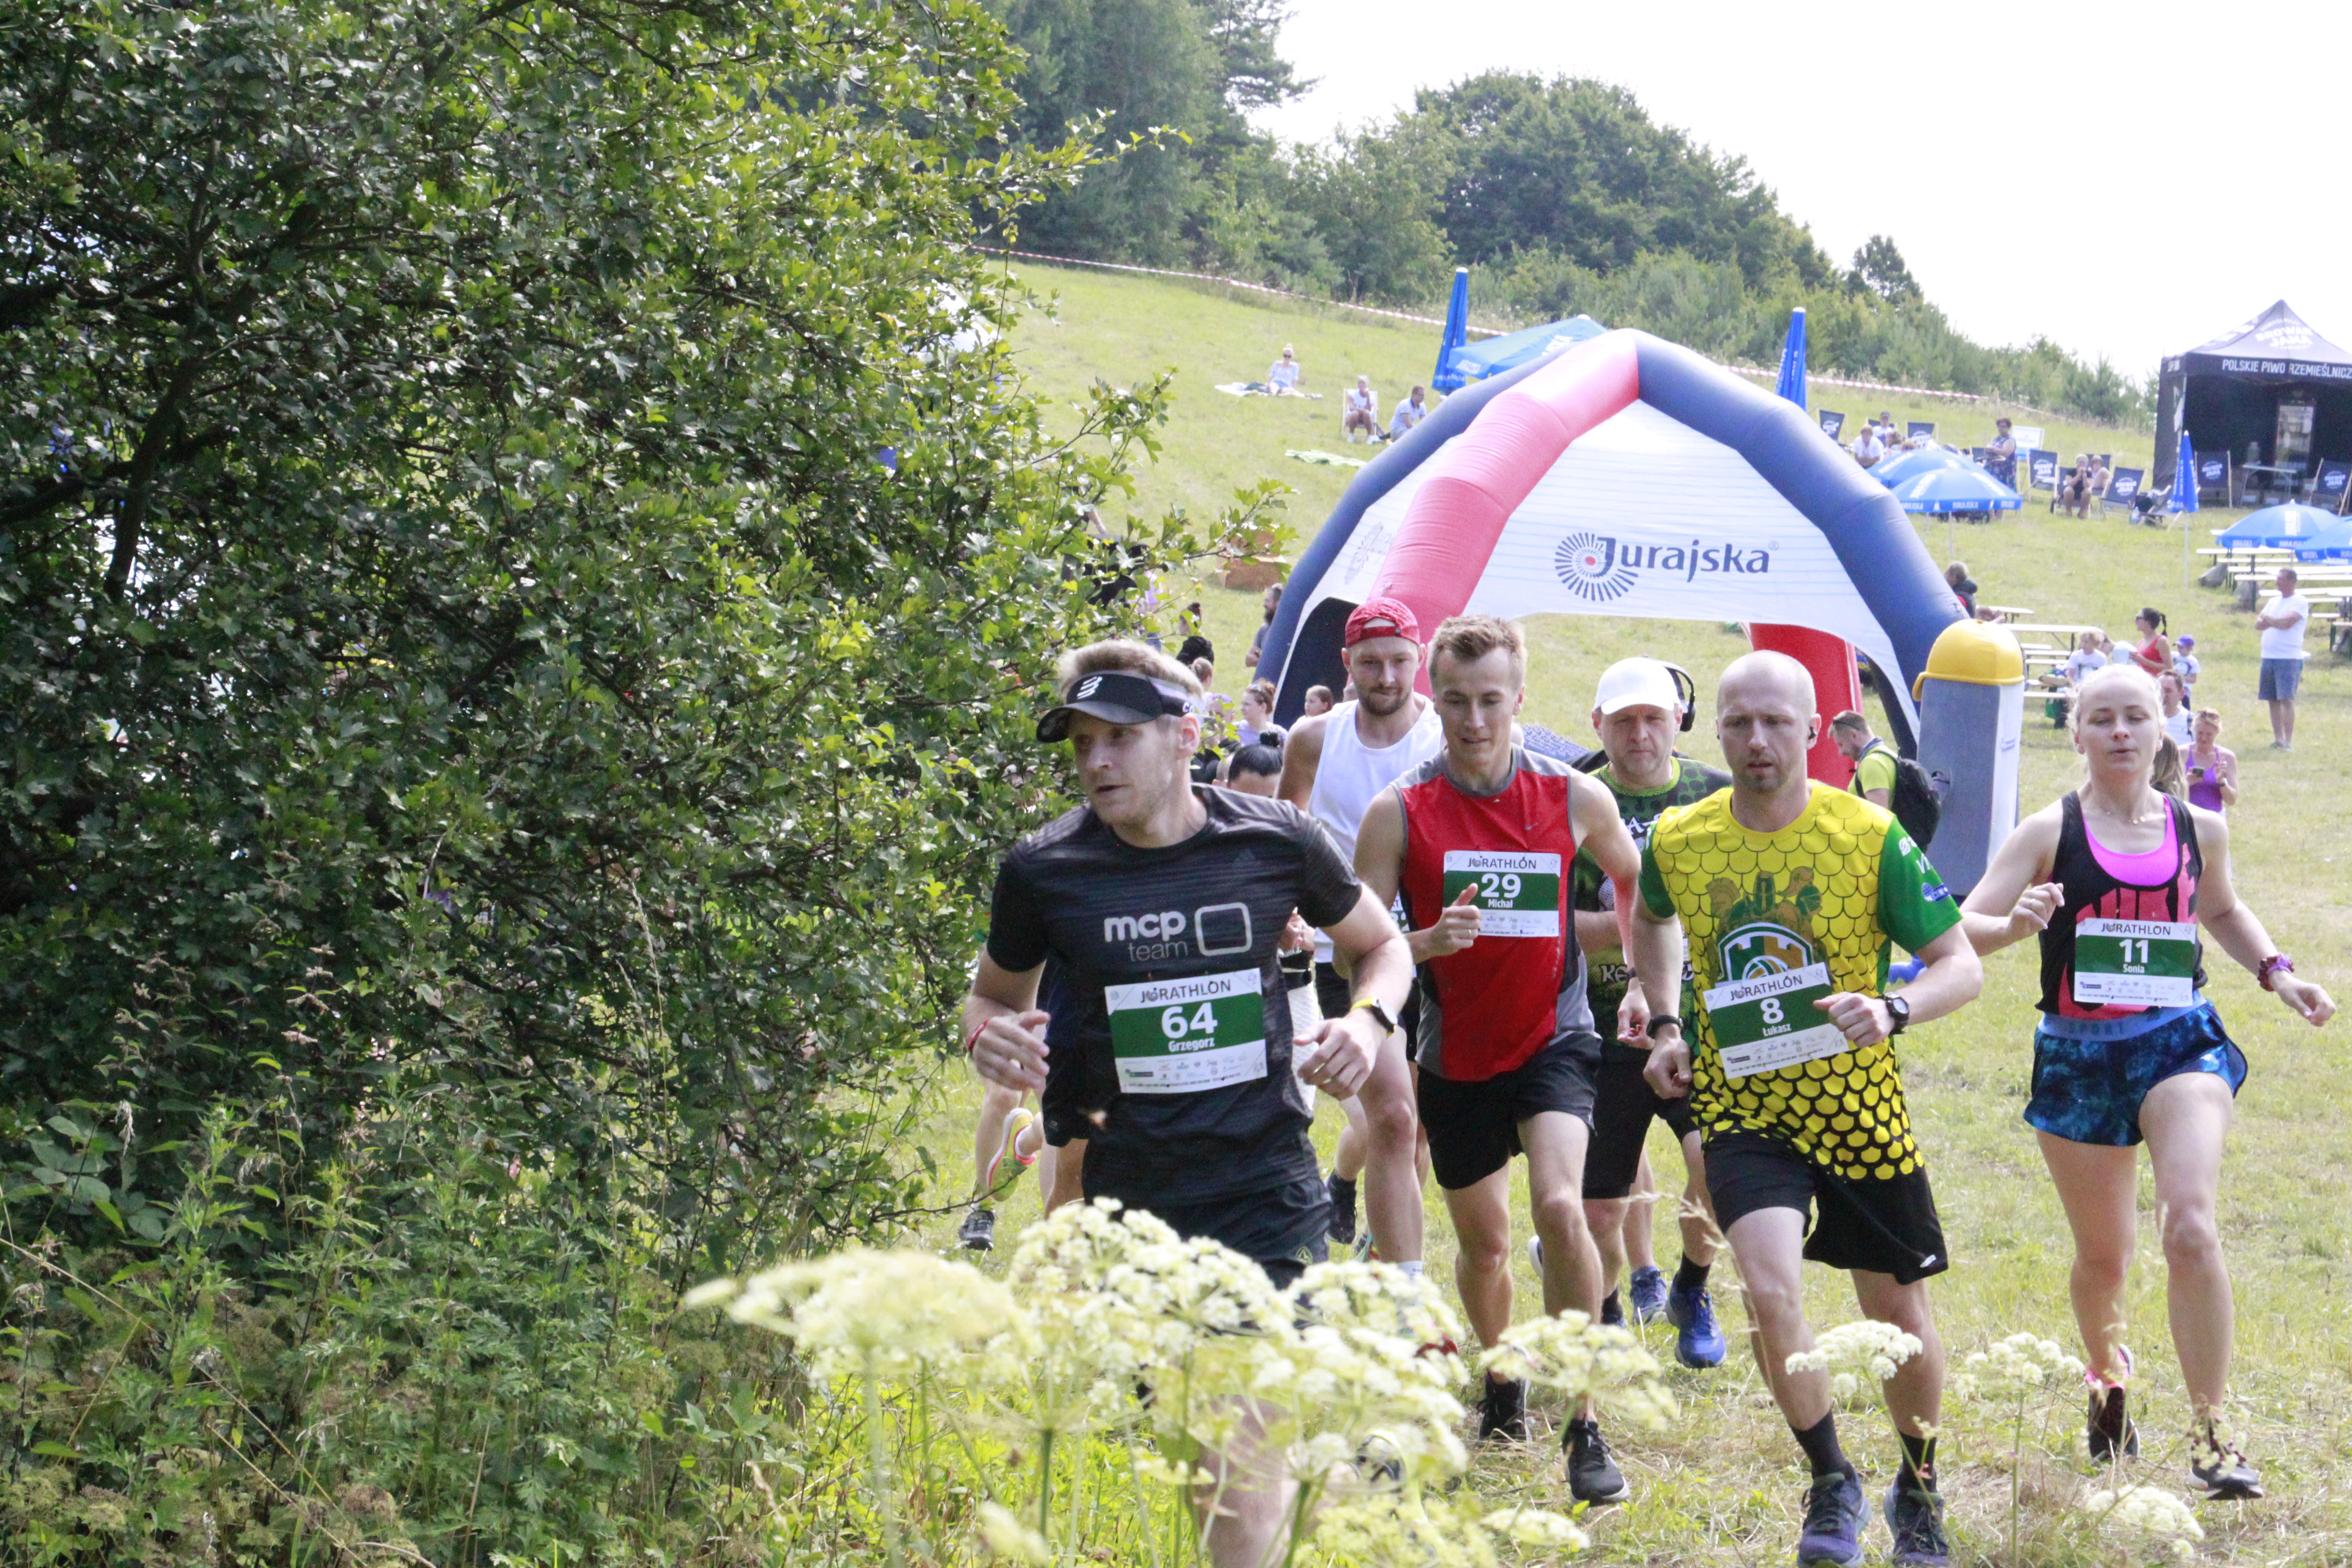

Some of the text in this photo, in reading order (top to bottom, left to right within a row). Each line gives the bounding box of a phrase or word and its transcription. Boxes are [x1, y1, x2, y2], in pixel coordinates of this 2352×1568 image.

[2222, 359, 2258, 372] POLSKIE
[2261, 361, 2286, 374] PIWO
[1594, 536, 1770, 583] Jurajska
[1481, 873, 1521, 898] 29
[1104, 911, 1186, 942] mcp
[1128, 940, 1188, 962] team
[2119, 939, 2149, 964] 11
[2123, 964, 2145, 974] Sonia
[1161, 1002, 1218, 1039] 64
[1760, 997, 1784, 1024] 8
[1169, 1037, 1215, 1052] Grzegorz
